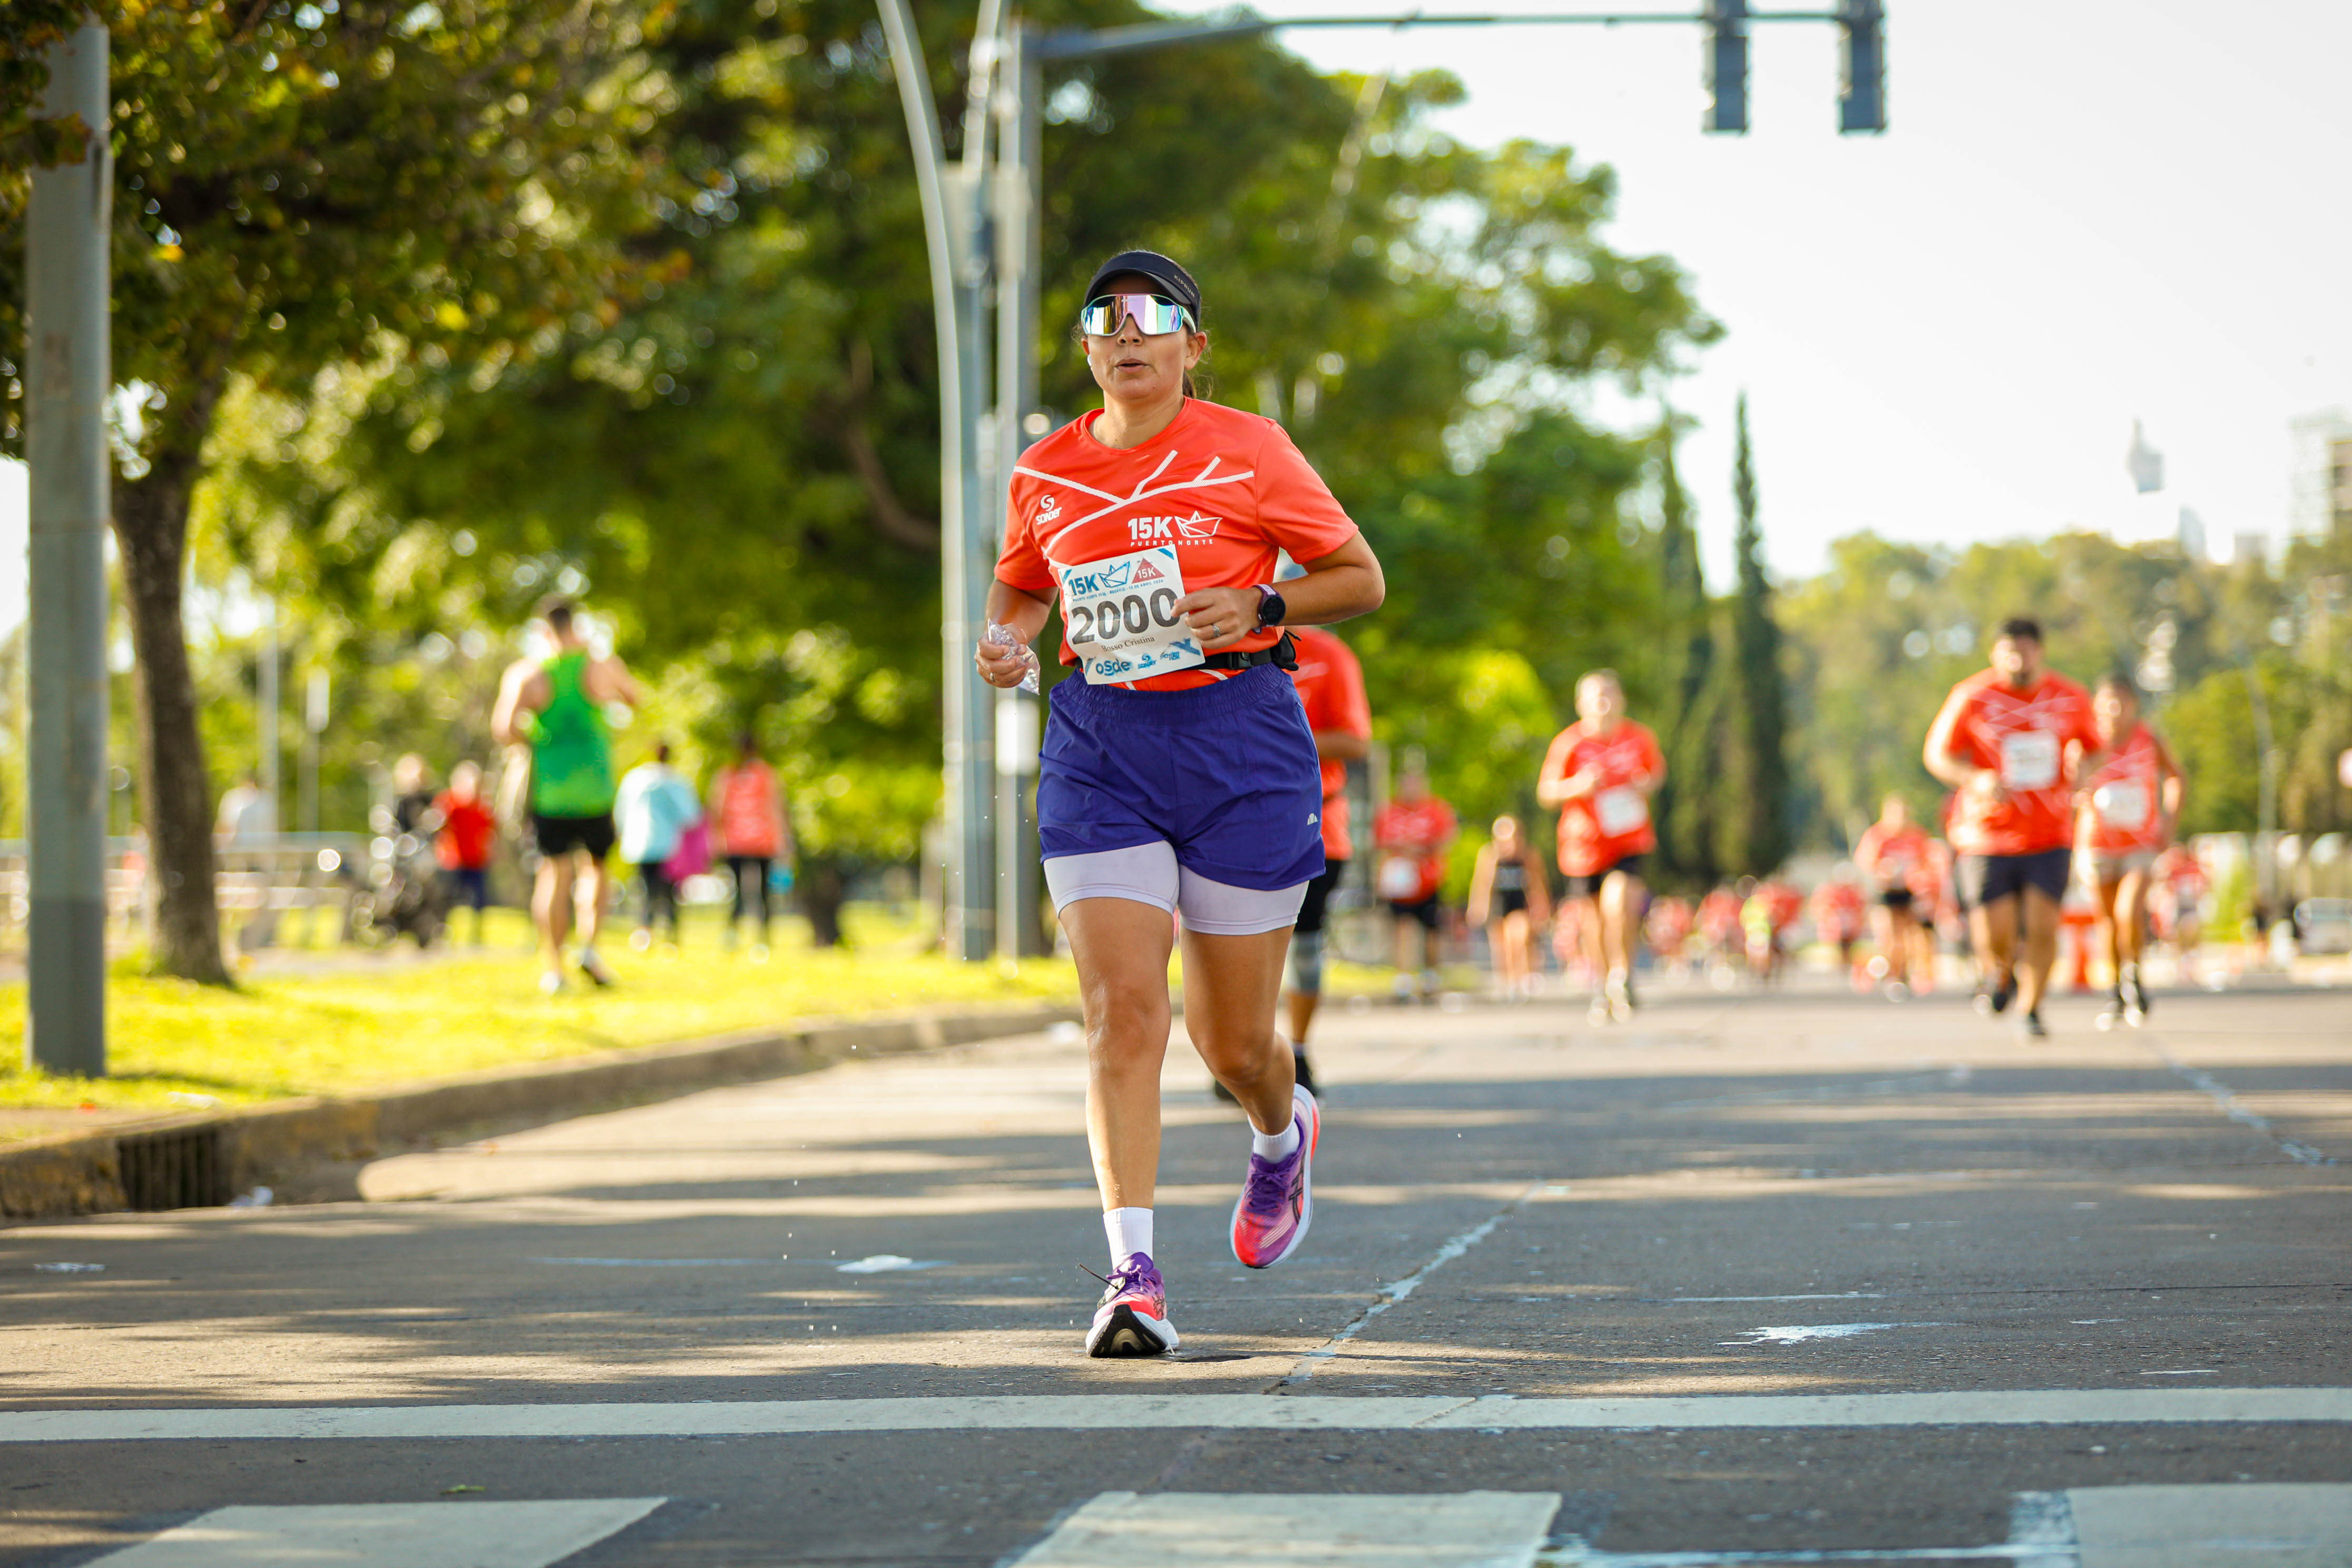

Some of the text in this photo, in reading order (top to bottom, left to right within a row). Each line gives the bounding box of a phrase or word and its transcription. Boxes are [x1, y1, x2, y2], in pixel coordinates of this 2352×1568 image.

[1174, 275, 1195, 298] KIPRUN
[1128, 516, 1173, 540] 15K
[1137, 566, 1157, 579] 15K
[1069, 573, 1100, 596] 15K
[1071, 587, 1180, 644] 2000
[1101, 637, 1155, 653] Bosso Cristina
